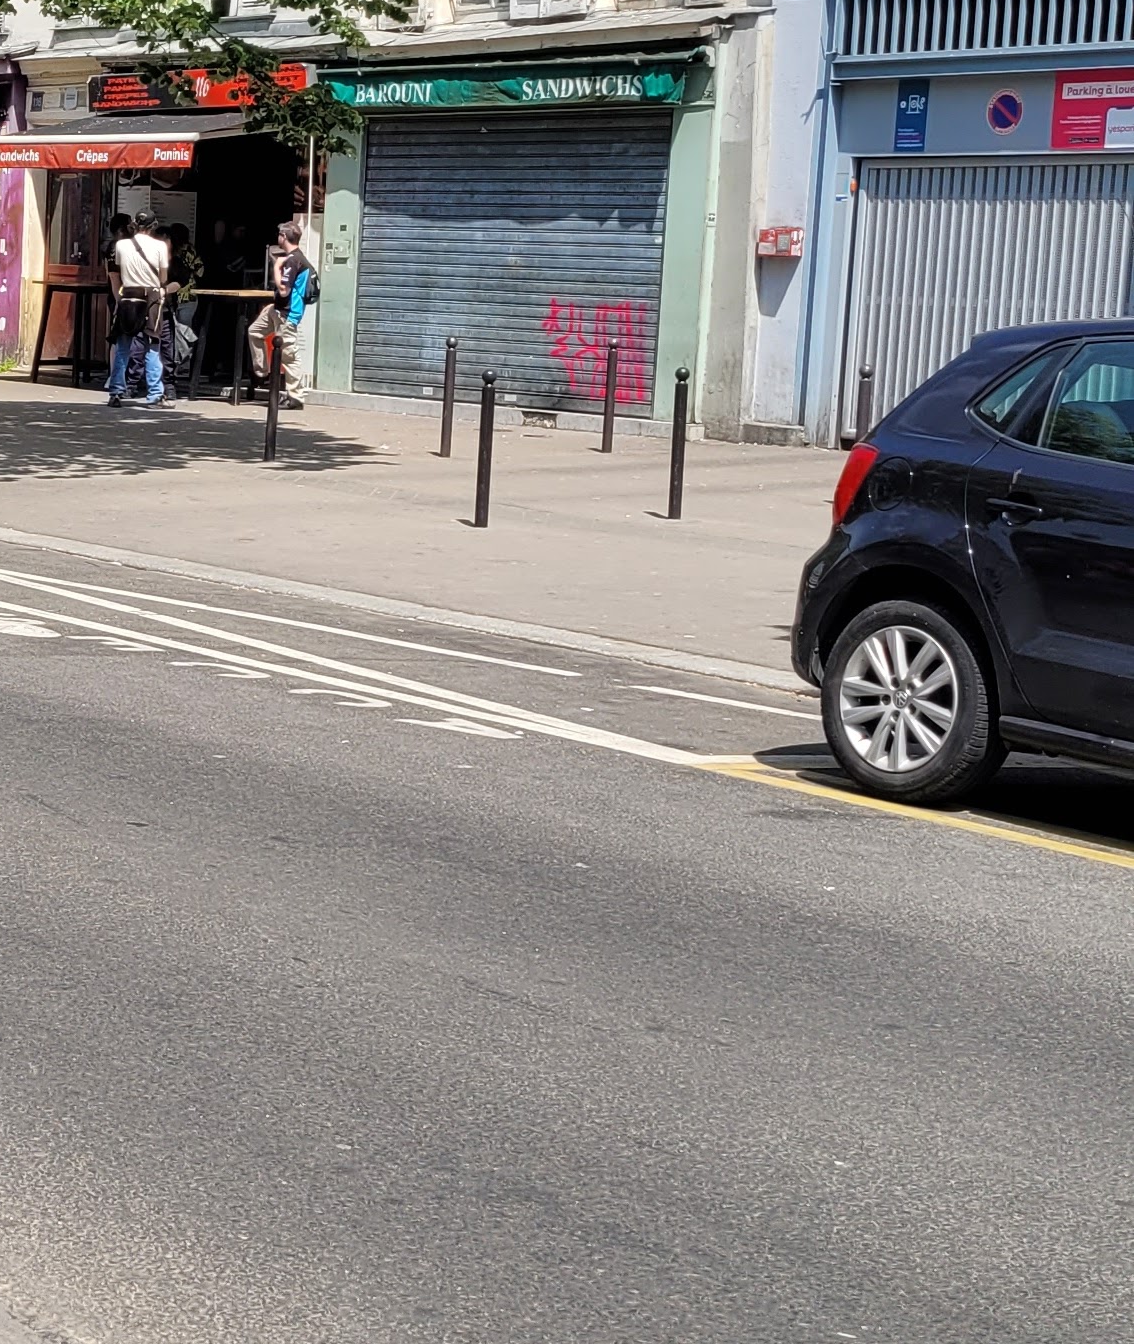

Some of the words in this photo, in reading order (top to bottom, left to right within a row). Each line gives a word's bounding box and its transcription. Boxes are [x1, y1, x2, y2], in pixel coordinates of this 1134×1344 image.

[355, 82, 433, 103] BAROUNI
[522, 74, 644, 101] SANDWICHS
[1067, 85, 1104, 97] Parking
[1105, 84, 1113, 95] à
[1114, 85, 1134, 95] loue
[76, 148, 109, 164] Crêpes
[153, 147, 190, 161] Paninis
